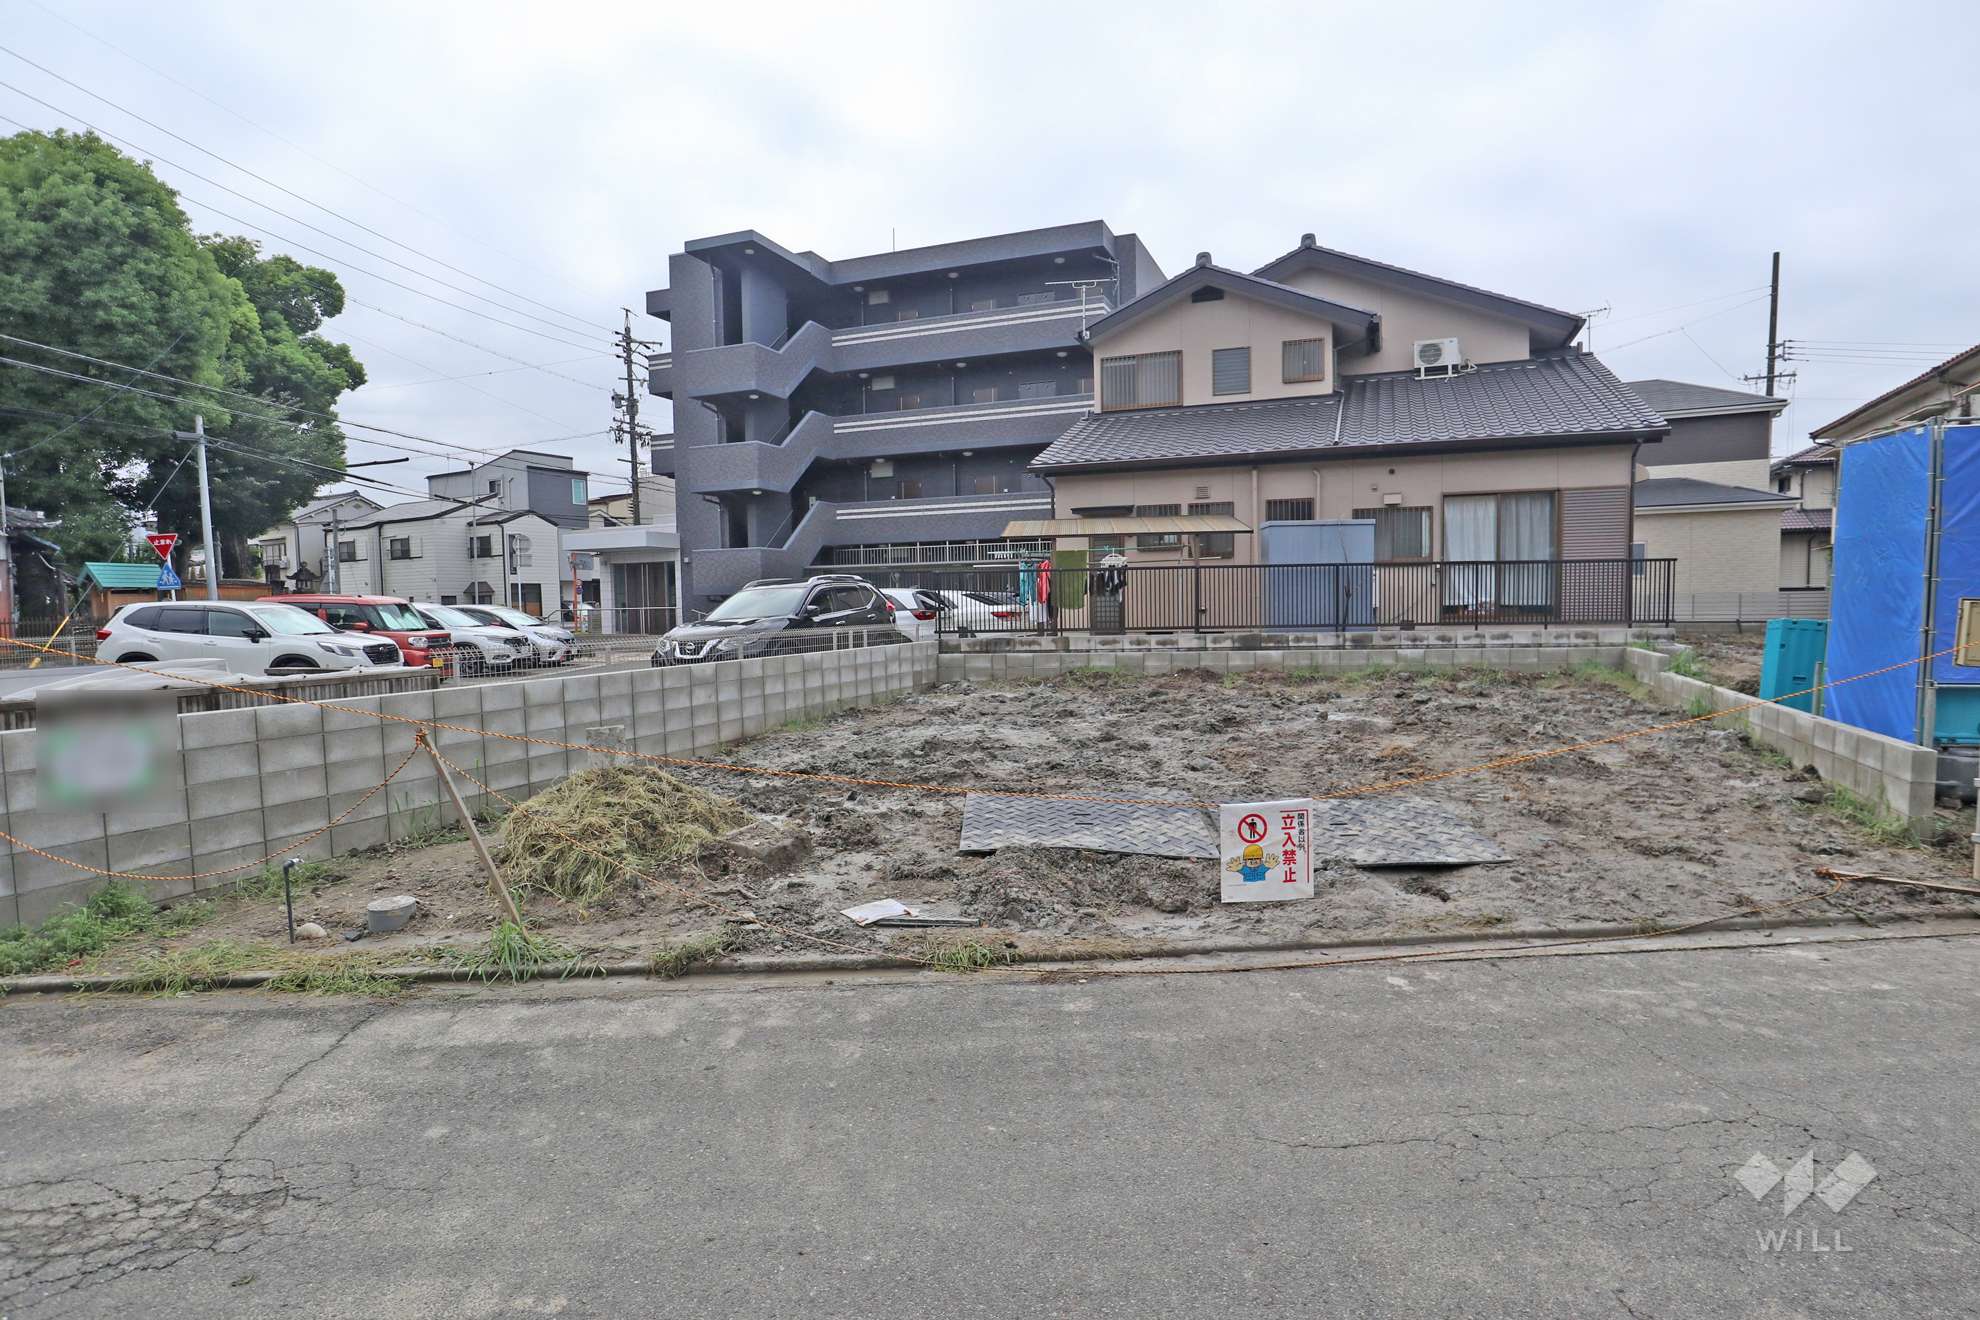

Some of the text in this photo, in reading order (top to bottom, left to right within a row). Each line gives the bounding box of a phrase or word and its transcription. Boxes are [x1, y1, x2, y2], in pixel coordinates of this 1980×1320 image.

[1281, 814, 1297, 883] 立入禁止
[1297, 813, 1306, 852] 関係者以外
